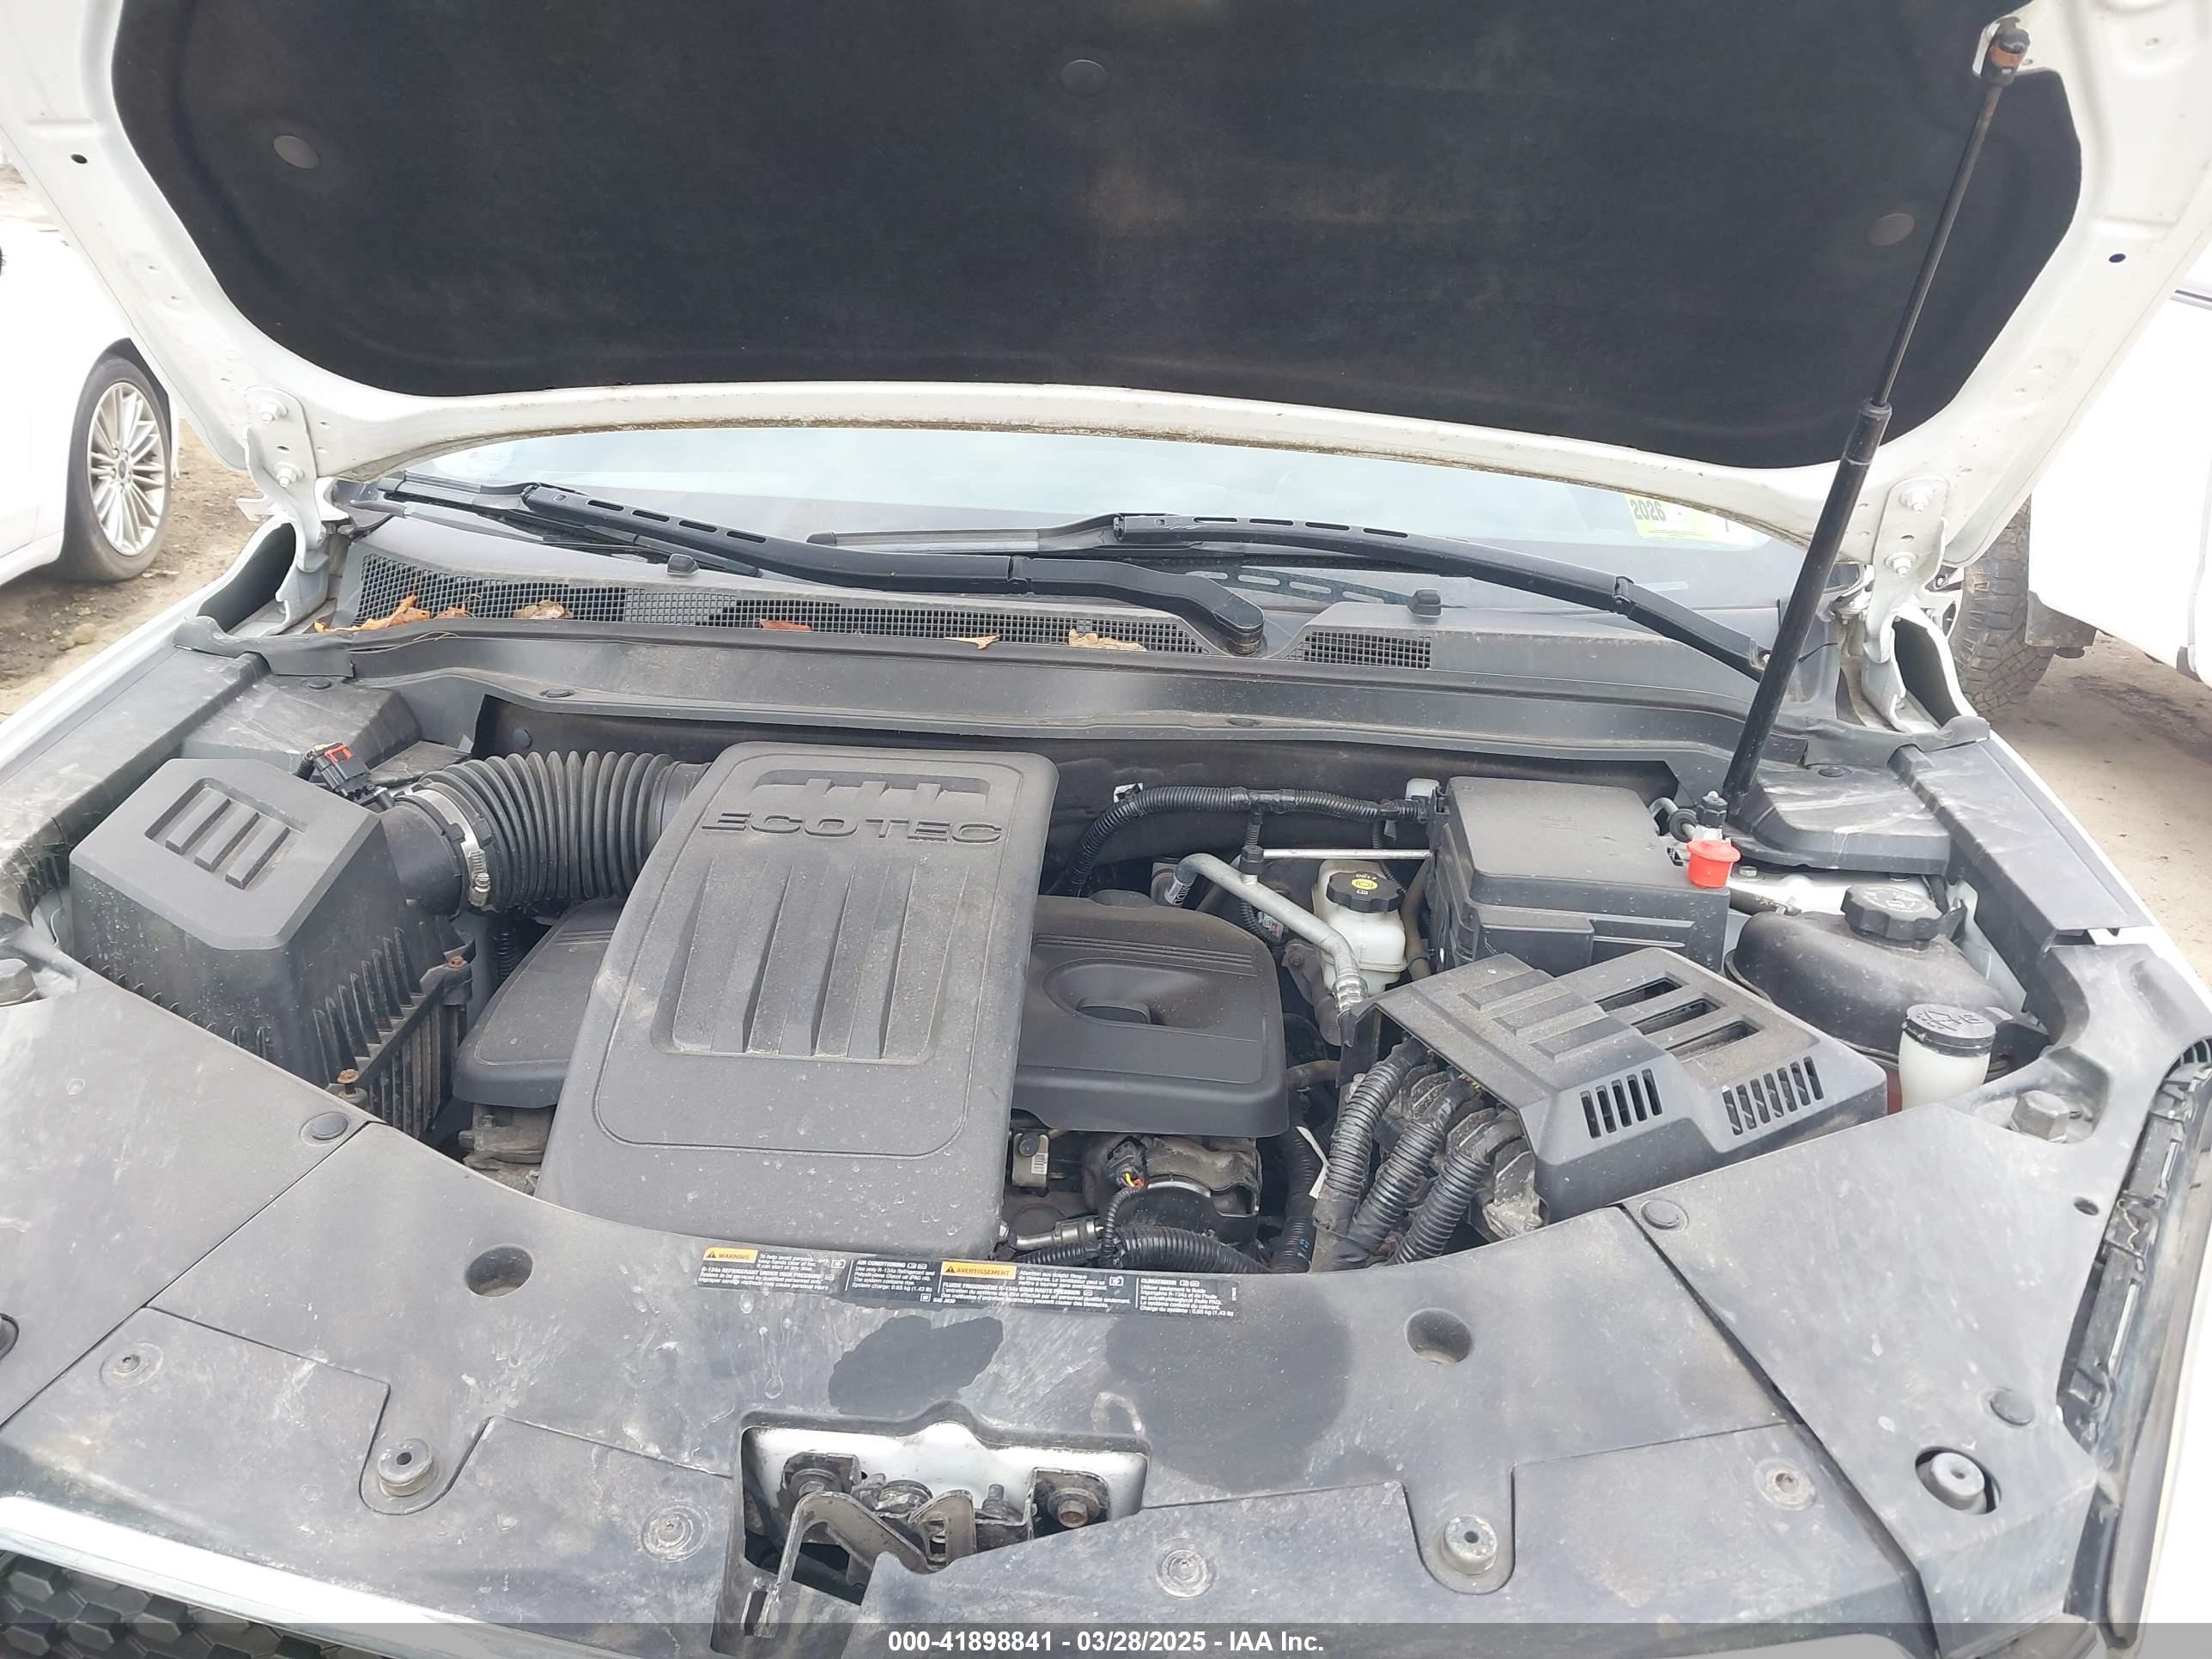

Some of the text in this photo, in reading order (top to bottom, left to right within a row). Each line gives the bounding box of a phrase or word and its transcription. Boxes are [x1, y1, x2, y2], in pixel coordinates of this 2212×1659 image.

[1630, 499, 1666, 522] 2026
[701, 811, 1003, 844] ECOTEC
[957, 1267, 1010, 1276] AVERTISSEMENT
